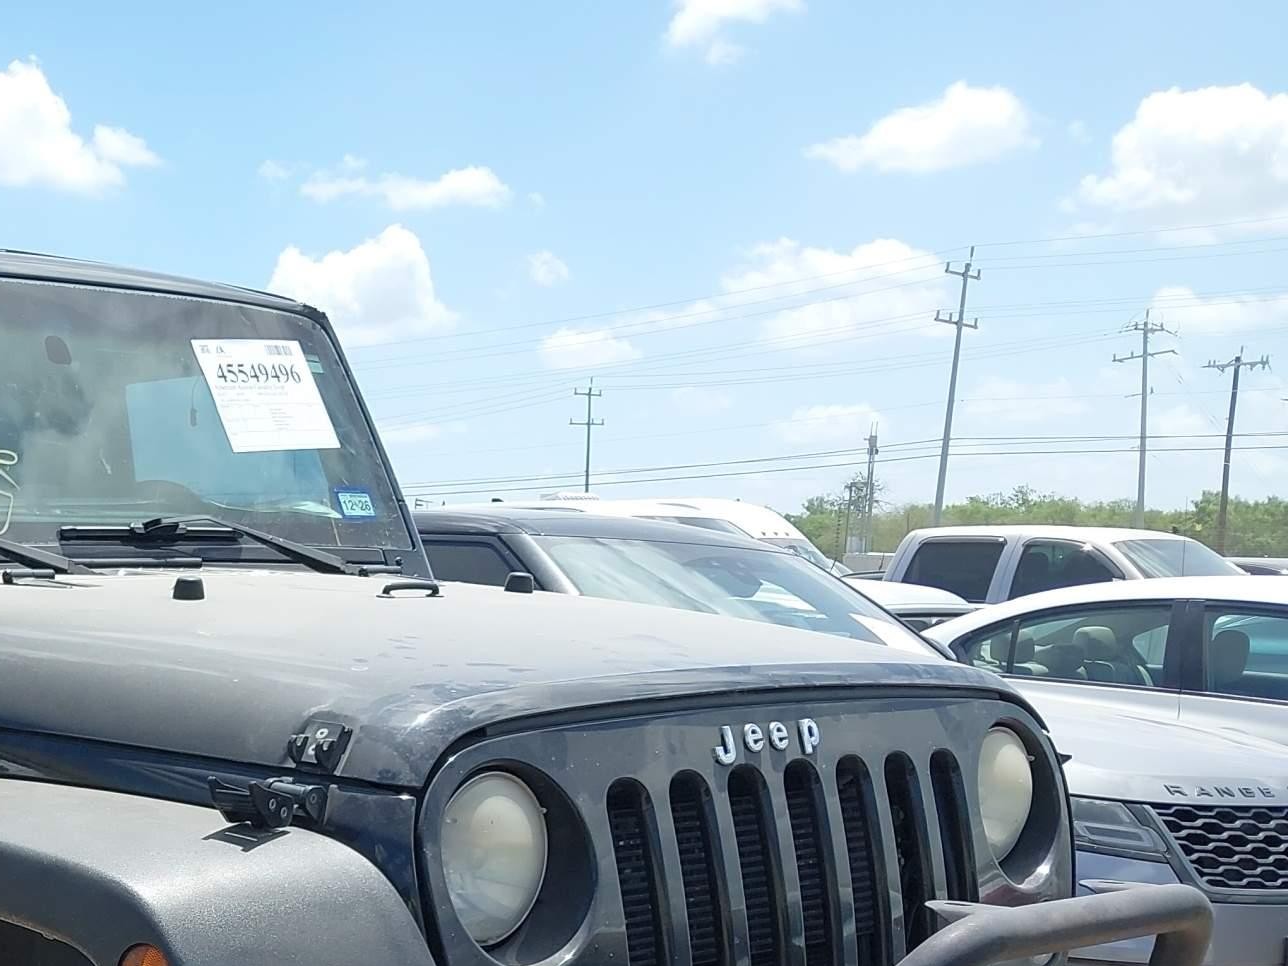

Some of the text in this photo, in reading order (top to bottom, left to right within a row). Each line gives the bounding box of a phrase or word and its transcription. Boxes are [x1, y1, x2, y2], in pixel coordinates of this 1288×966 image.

[216, 362, 302, 384] 45549496
[713, 718, 820, 765] Jeep
[1163, 783, 1276, 798] RANGE
